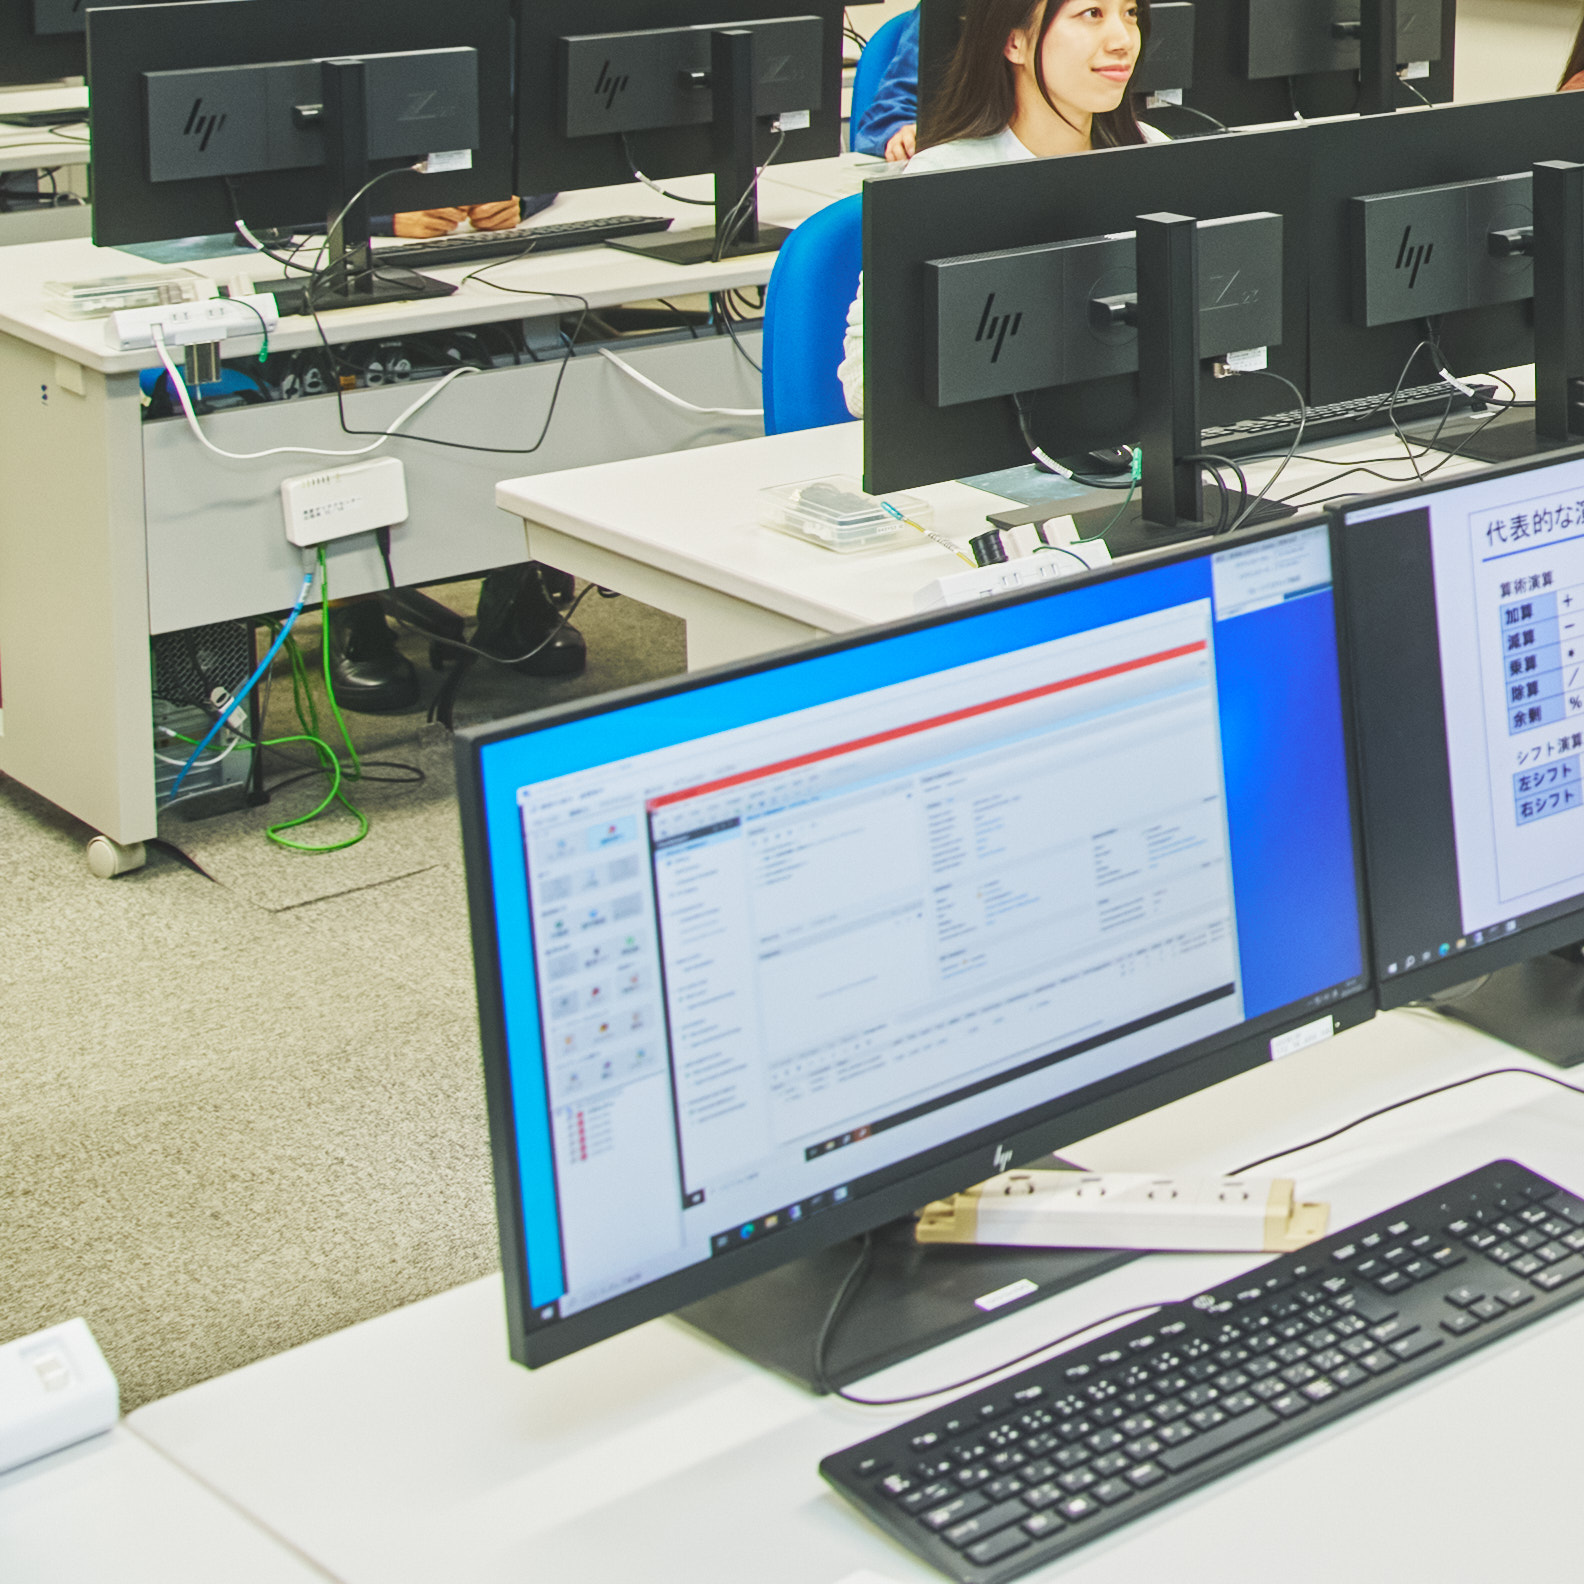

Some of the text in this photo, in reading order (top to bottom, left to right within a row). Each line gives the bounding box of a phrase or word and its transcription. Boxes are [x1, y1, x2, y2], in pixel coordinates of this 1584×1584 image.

[183, 97, 227, 153] hp
[1394, 224, 1434, 290] hp
[974, 292, 1023, 364] hp
[1569, 695, 1583, 710] %
[1517, 732, 1583, 766] シフト演算
[1519, 763, 1572, 793] 左シフト
[1521, 789, 1574, 818] 右シフト
